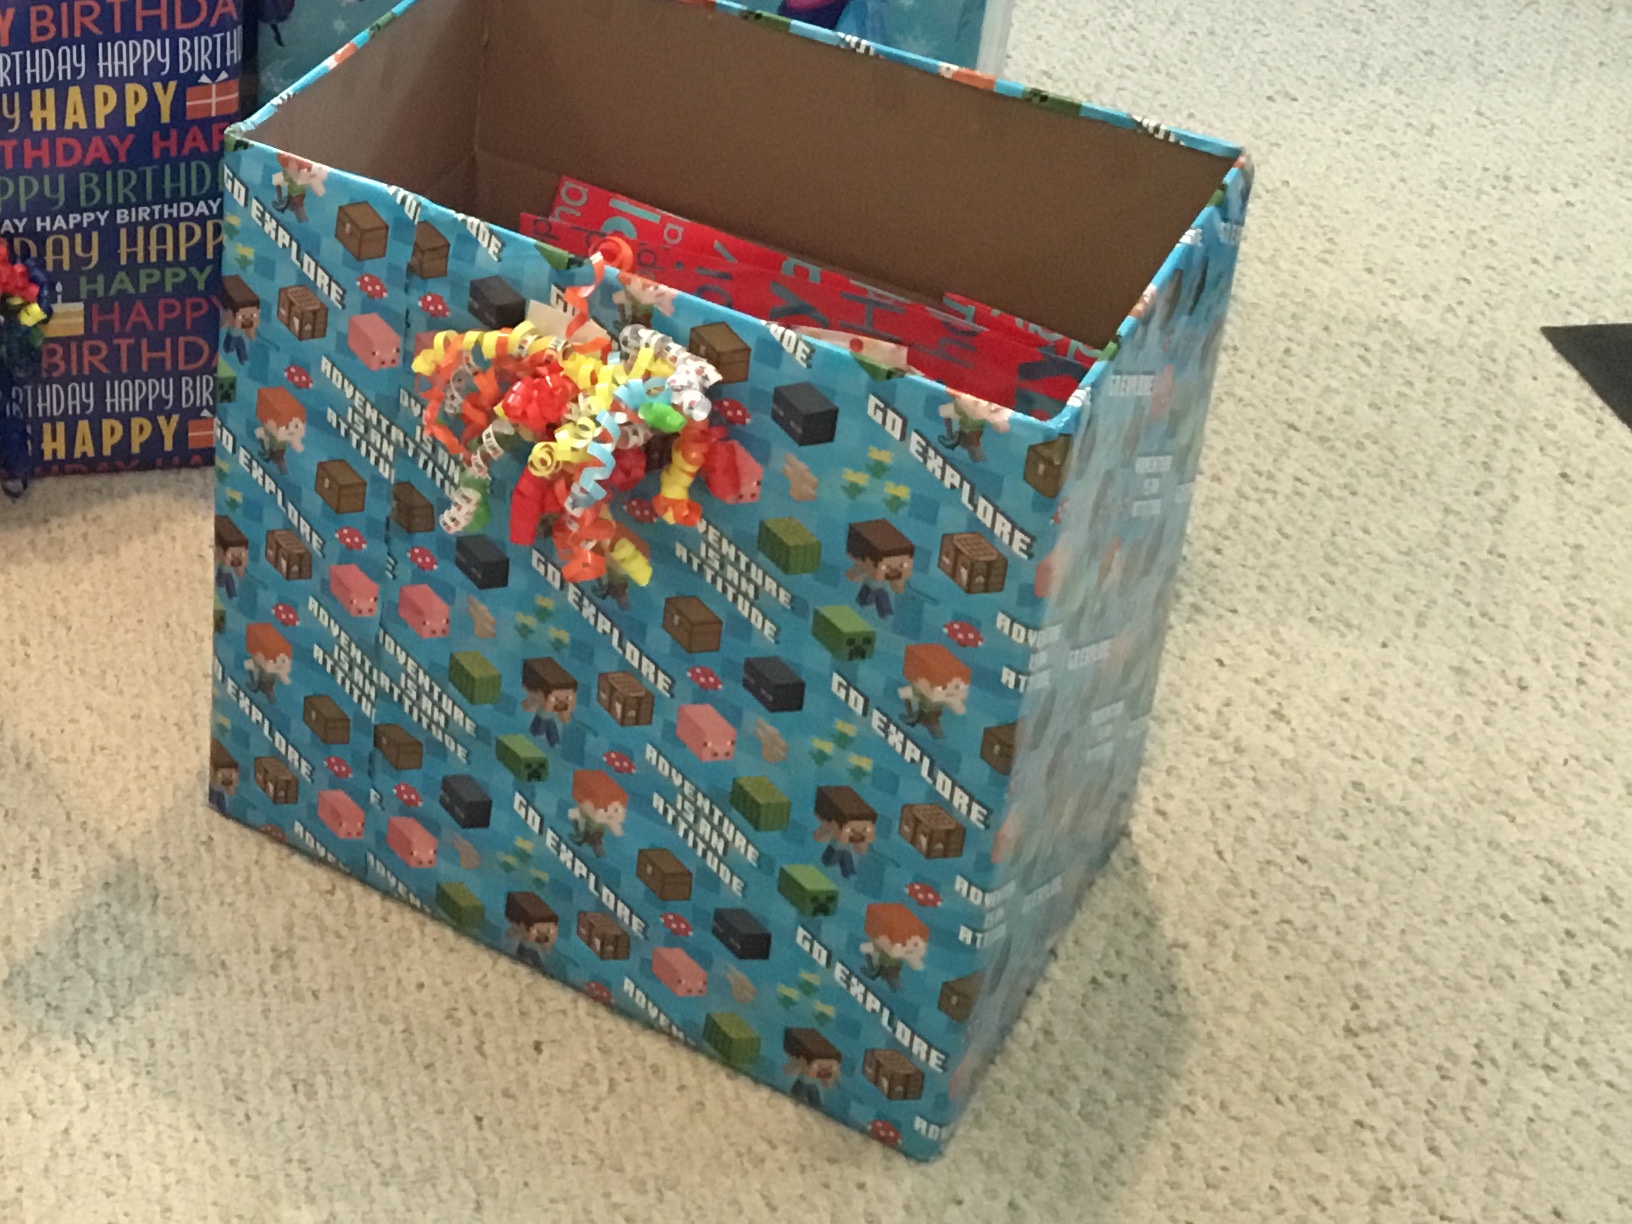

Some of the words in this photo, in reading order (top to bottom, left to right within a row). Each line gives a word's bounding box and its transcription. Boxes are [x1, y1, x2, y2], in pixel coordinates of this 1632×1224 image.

[97, 37, 170, 79] HAPPY
[29, 80, 179, 132] HAPPY
[78, 159, 225, 208] BIRTHD
[36, 209, 110, 235] HAPPY
[116, 198, 222, 225] BIRTHDAY
[79, 265, 214, 300] HAPPY
[250, 202, 347, 310] EXPLORE
[41, 335, 219, 378] BIRTHD
[105, 378, 174, 414] HAPPY
[41, 414, 180, 461] HAPPY
[347, 406, 365, 434] IS
[371, 428, 394, 462] AN
[238, 445, 326, 559] EXPLORE
[867, 393, 907, 440] GO
[908, 431, 1037, 561] EXPLORE
[675, 541, 778, 645] ATTITUDE
[697, 518, 792, 610] VENTURE
[700, 540, 721, 570] IS
[726, 564, 756, 600] AN
[532, 548, 563, 591] GO
[567, 582, 676, 698] EXPLORE
[333, 644, 350, 671] IS
[353, 666, 376, 702] AN
[400, 672, 417, 701] IS
[421, 693, 446, 729] AN
[226, 680, 315, 782] EXPLORE
[831, 671, 868, 717] GO
[870, 713, 992, 830] EXPLORE
[645, 742, 760, 869] ADVENTURE
[676, 793, 695, 824] IS
[699, 817, 725, 857] AN
[513, 791, 545, 835] GO
[545, 827, 650, 939] EXPLORE
[652, 791, 745, 898] ATTITUDE
[796, 926, 831, 969] GO
[833, 963, 949, 1073] EXPLORE
